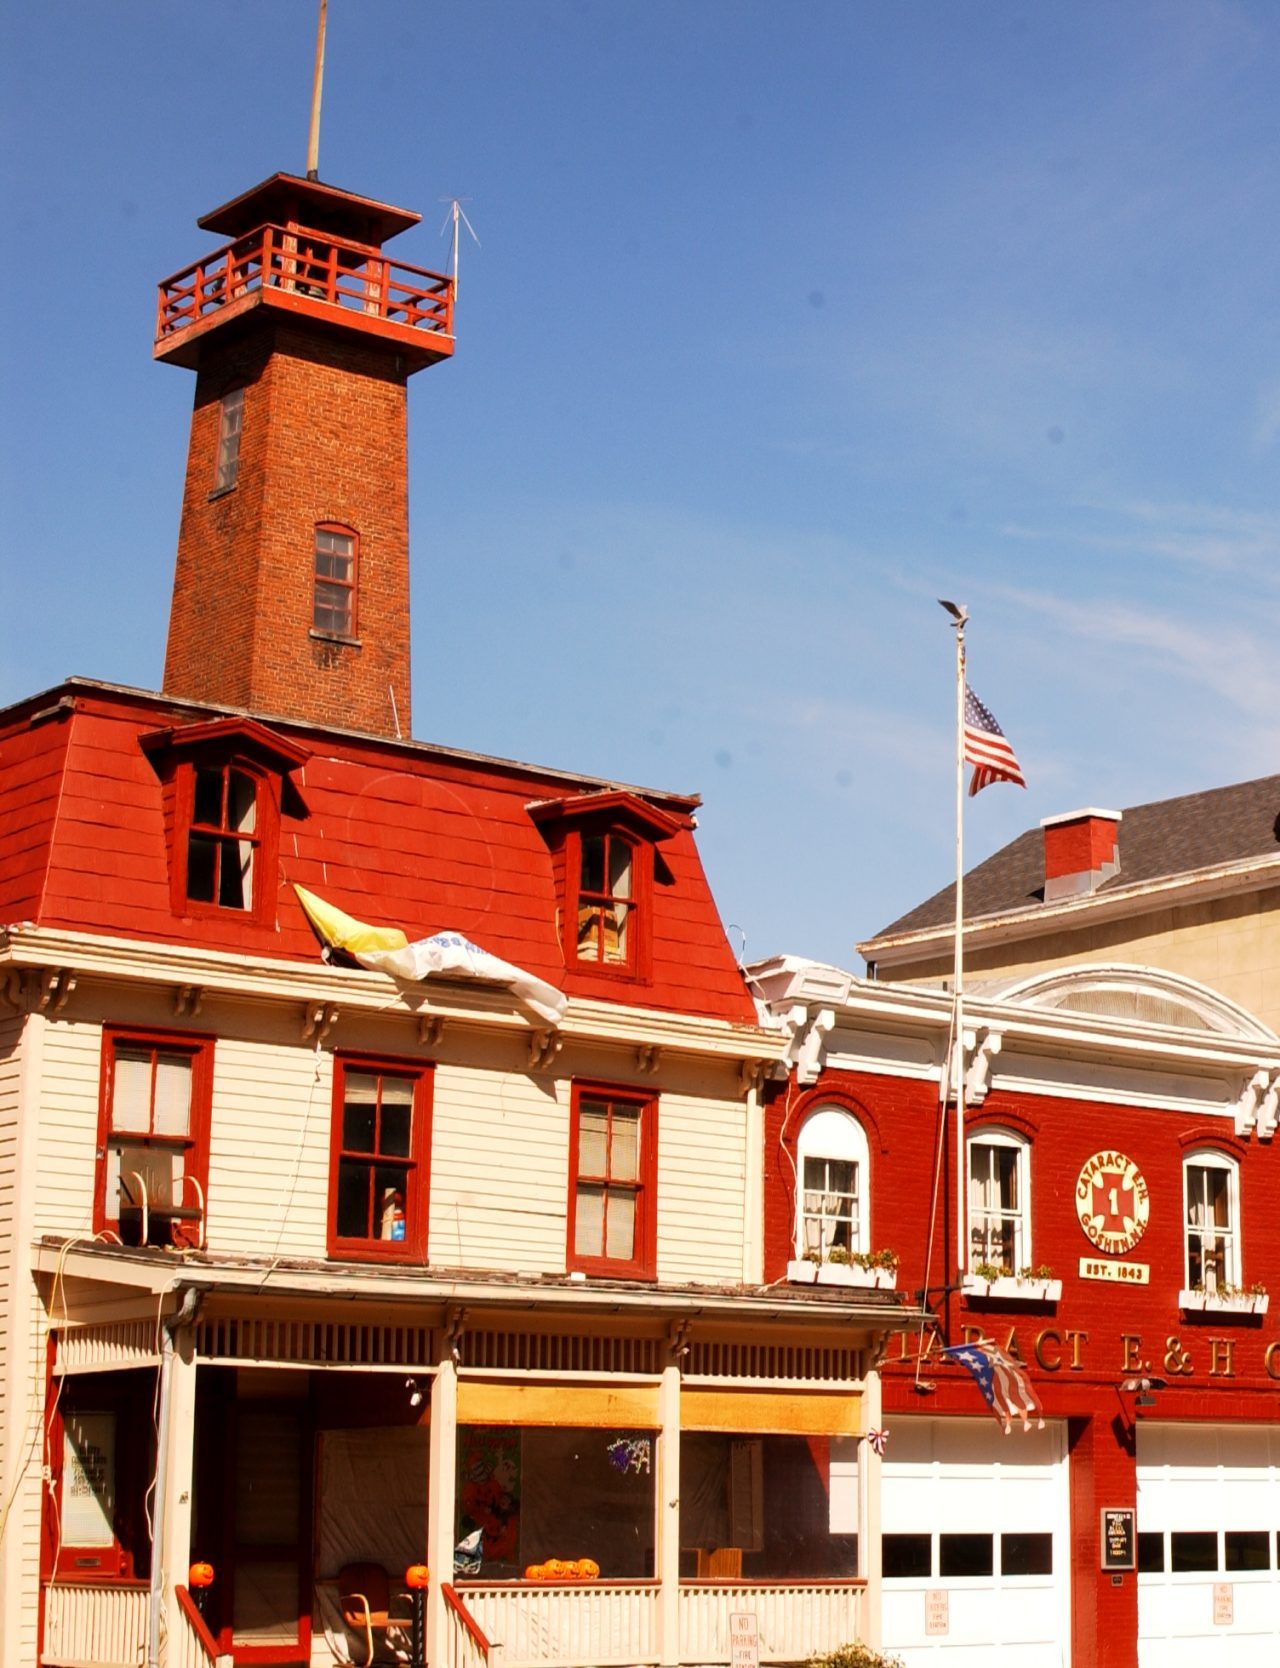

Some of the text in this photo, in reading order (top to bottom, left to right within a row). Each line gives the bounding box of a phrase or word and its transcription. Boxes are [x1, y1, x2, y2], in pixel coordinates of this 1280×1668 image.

[1078, 1153, 1131, 1200] CATARACT
[1108, 1187, 1119, 1216] 1
[1086, 1263, 1143, 1280] EST. 1843
[1120, 1333, 1152, 1374] E.
[1164, 1336, 1195, 1376] &
[1208, 1337, 1236, 1377] H
[738, 1617, 749, 1630] NO
[732, 1633, 758, 1648] PARKING
